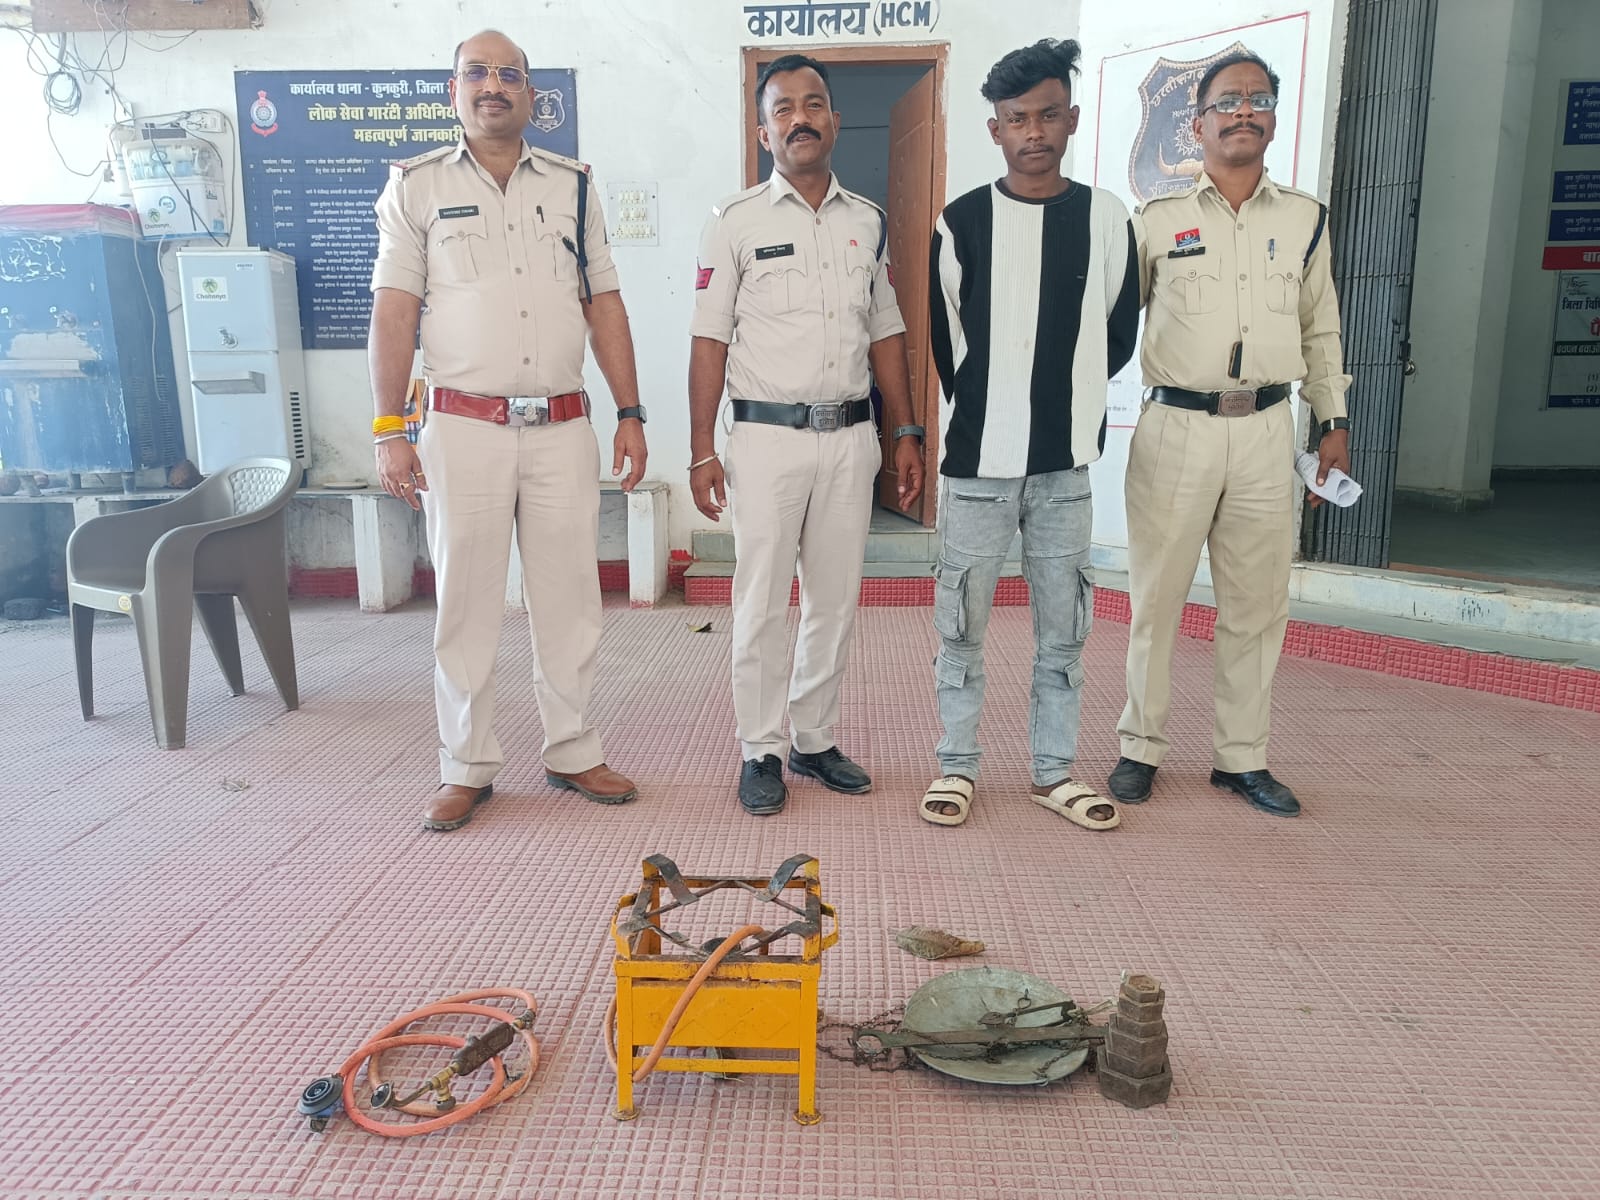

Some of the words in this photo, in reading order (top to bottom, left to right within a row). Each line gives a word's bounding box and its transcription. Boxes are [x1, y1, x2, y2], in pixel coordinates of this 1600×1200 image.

[873, 0, 940, 36] (HCM)
[289, 80, 334, 95] कार्यालय
[416, 80, 444, 94] जिला
[308, 103, 337, 120] लोक
[340, 103, 364, 120] सेवा
[367, 102, 401, 120] गारंटी
[405, 103, 460, 120] अधिनिय
[353, 125, 408, 147] महत्वपूर्ण
